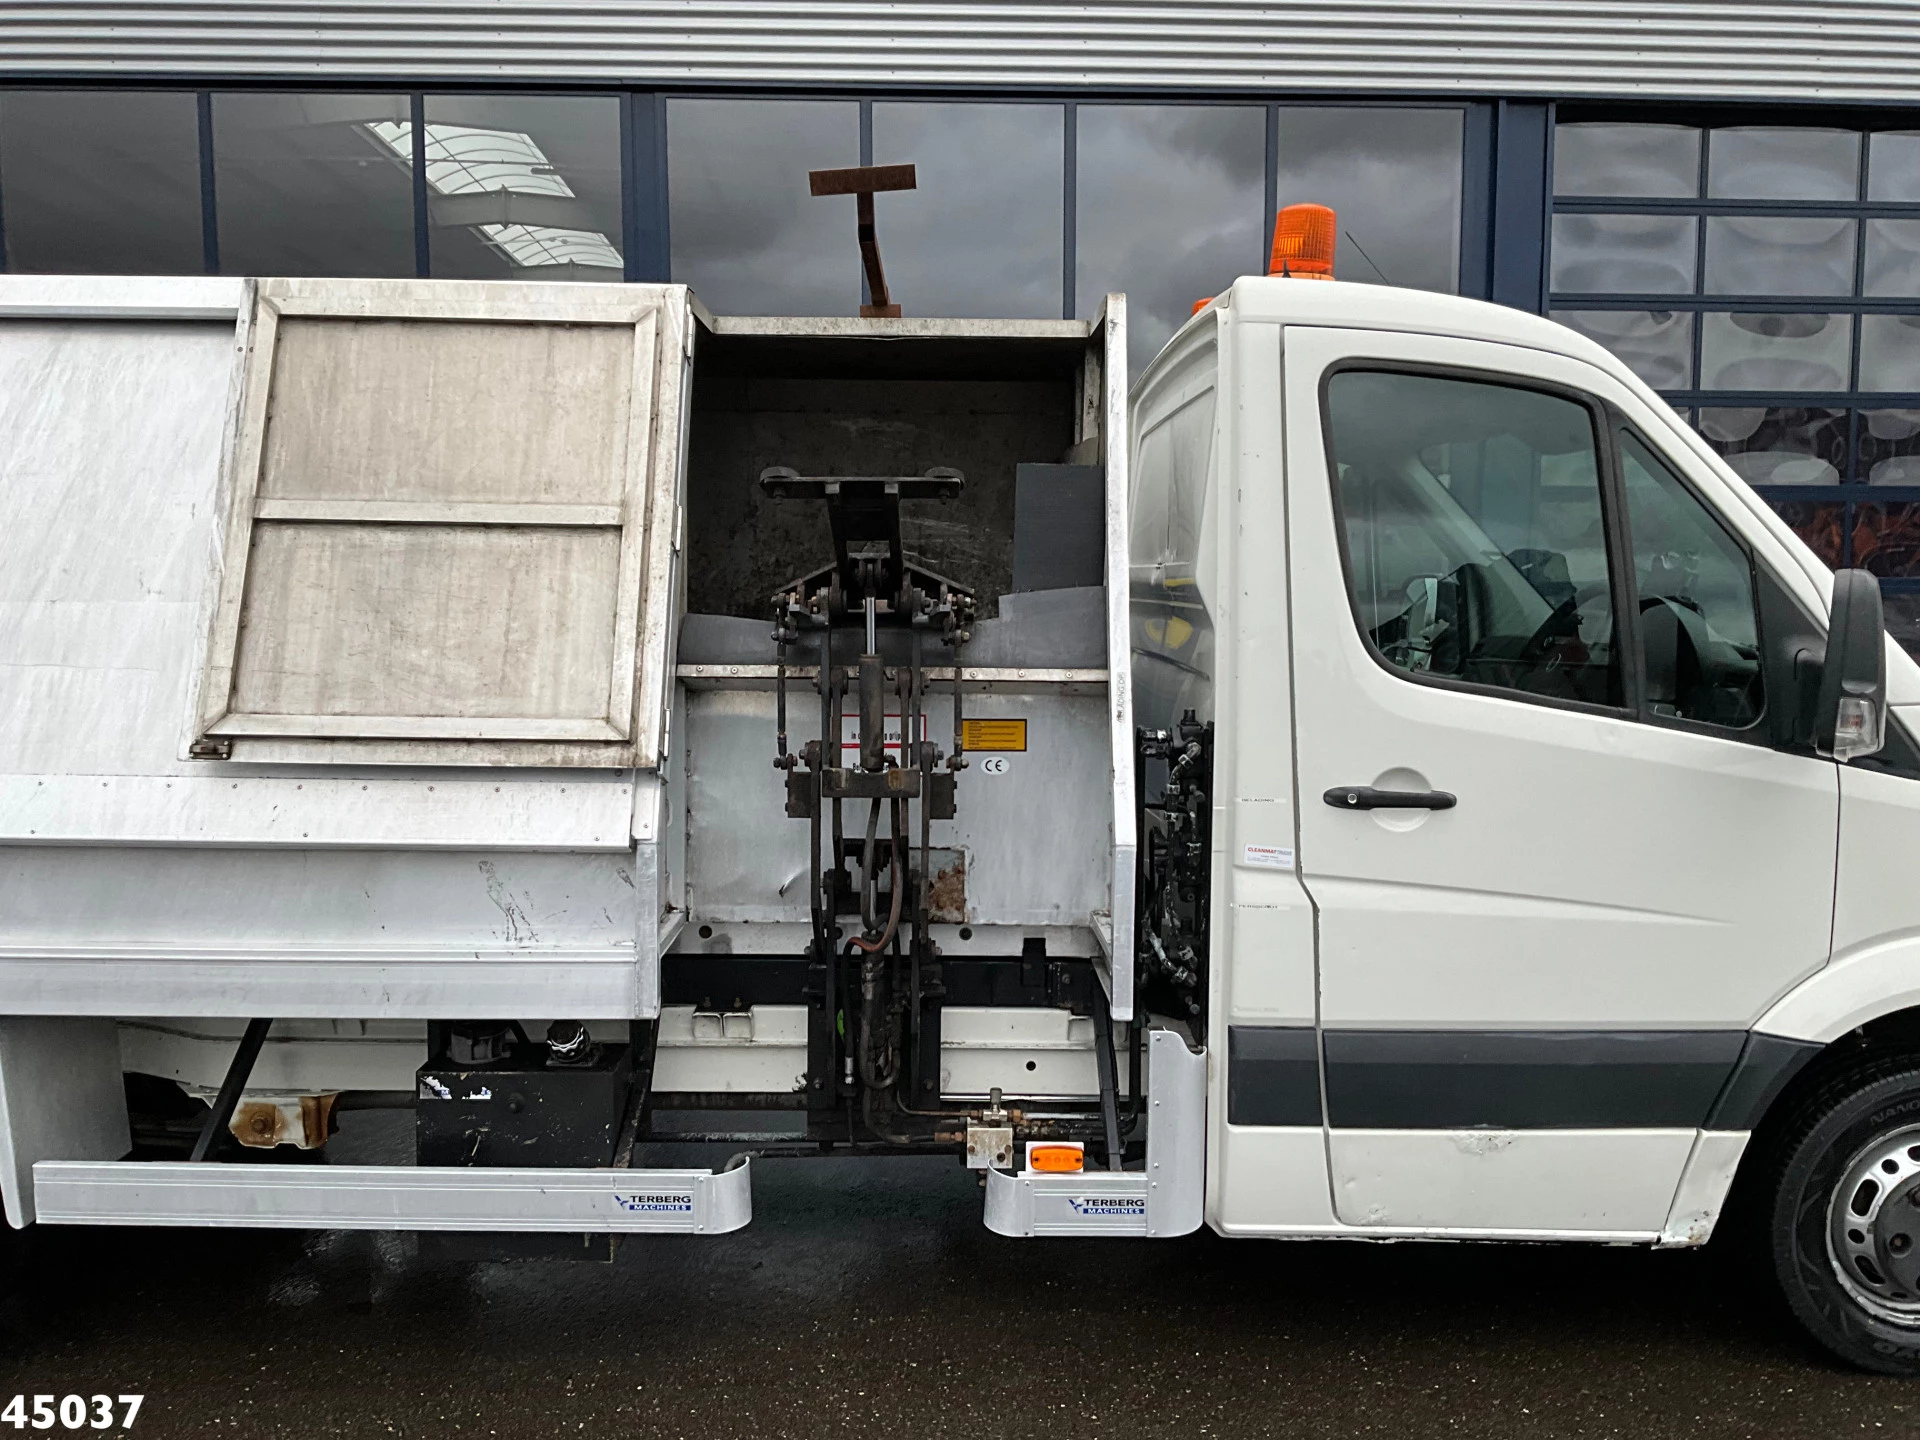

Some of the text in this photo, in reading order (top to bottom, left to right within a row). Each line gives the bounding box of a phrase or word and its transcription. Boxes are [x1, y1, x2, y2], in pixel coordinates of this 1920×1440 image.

[985, 759, 1003, 772] CE
[630, 1195, 692, 1204] TERBERG
[1084, 1199, 1145, 1207] TERBERG
